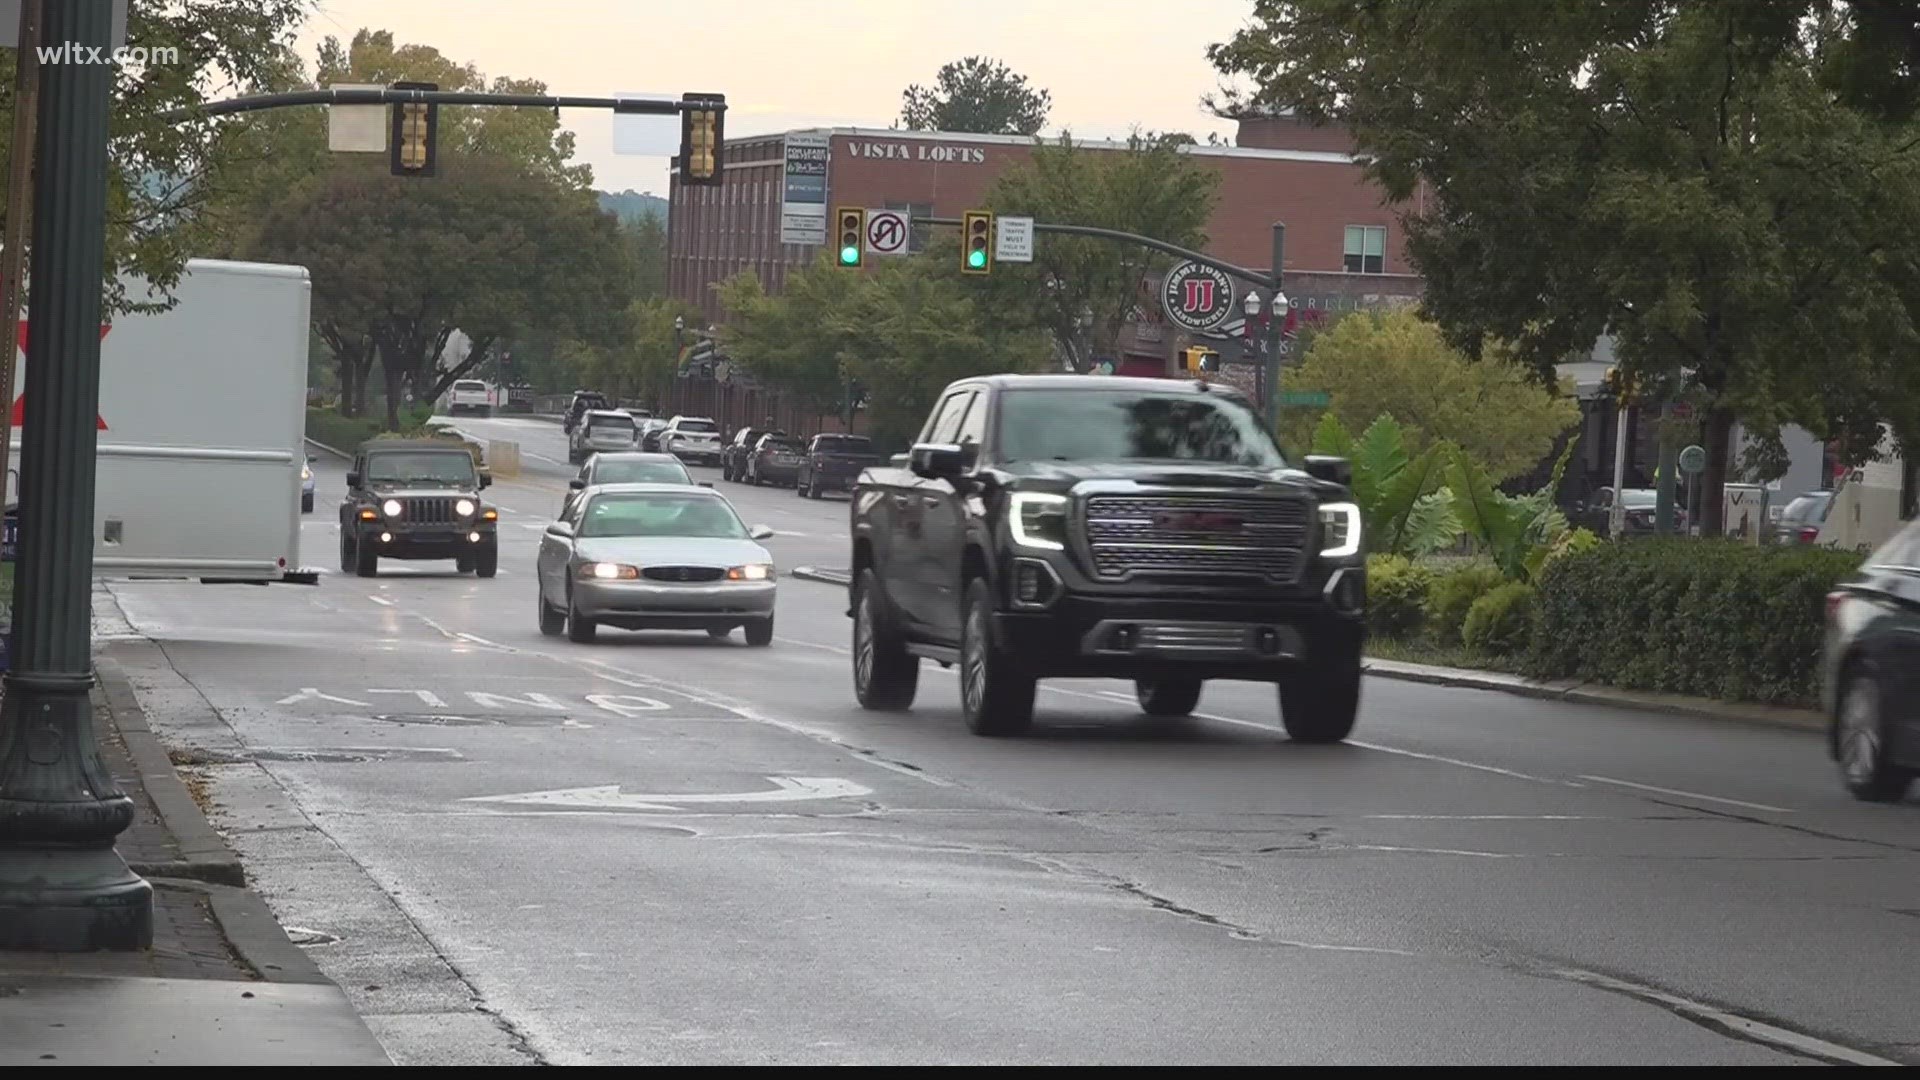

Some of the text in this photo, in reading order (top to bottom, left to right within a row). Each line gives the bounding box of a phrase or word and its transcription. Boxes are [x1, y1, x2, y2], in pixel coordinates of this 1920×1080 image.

[848, 142, 985, 163] VISTA LOFTS
[1168, 264, 1230, 295] JIMMY JOHN'S
[1183, 279, 1215, 312] JJ
[1172, 306, 1226, 326] SANDWICHES
[276, 686, 672, 718] ONLY
